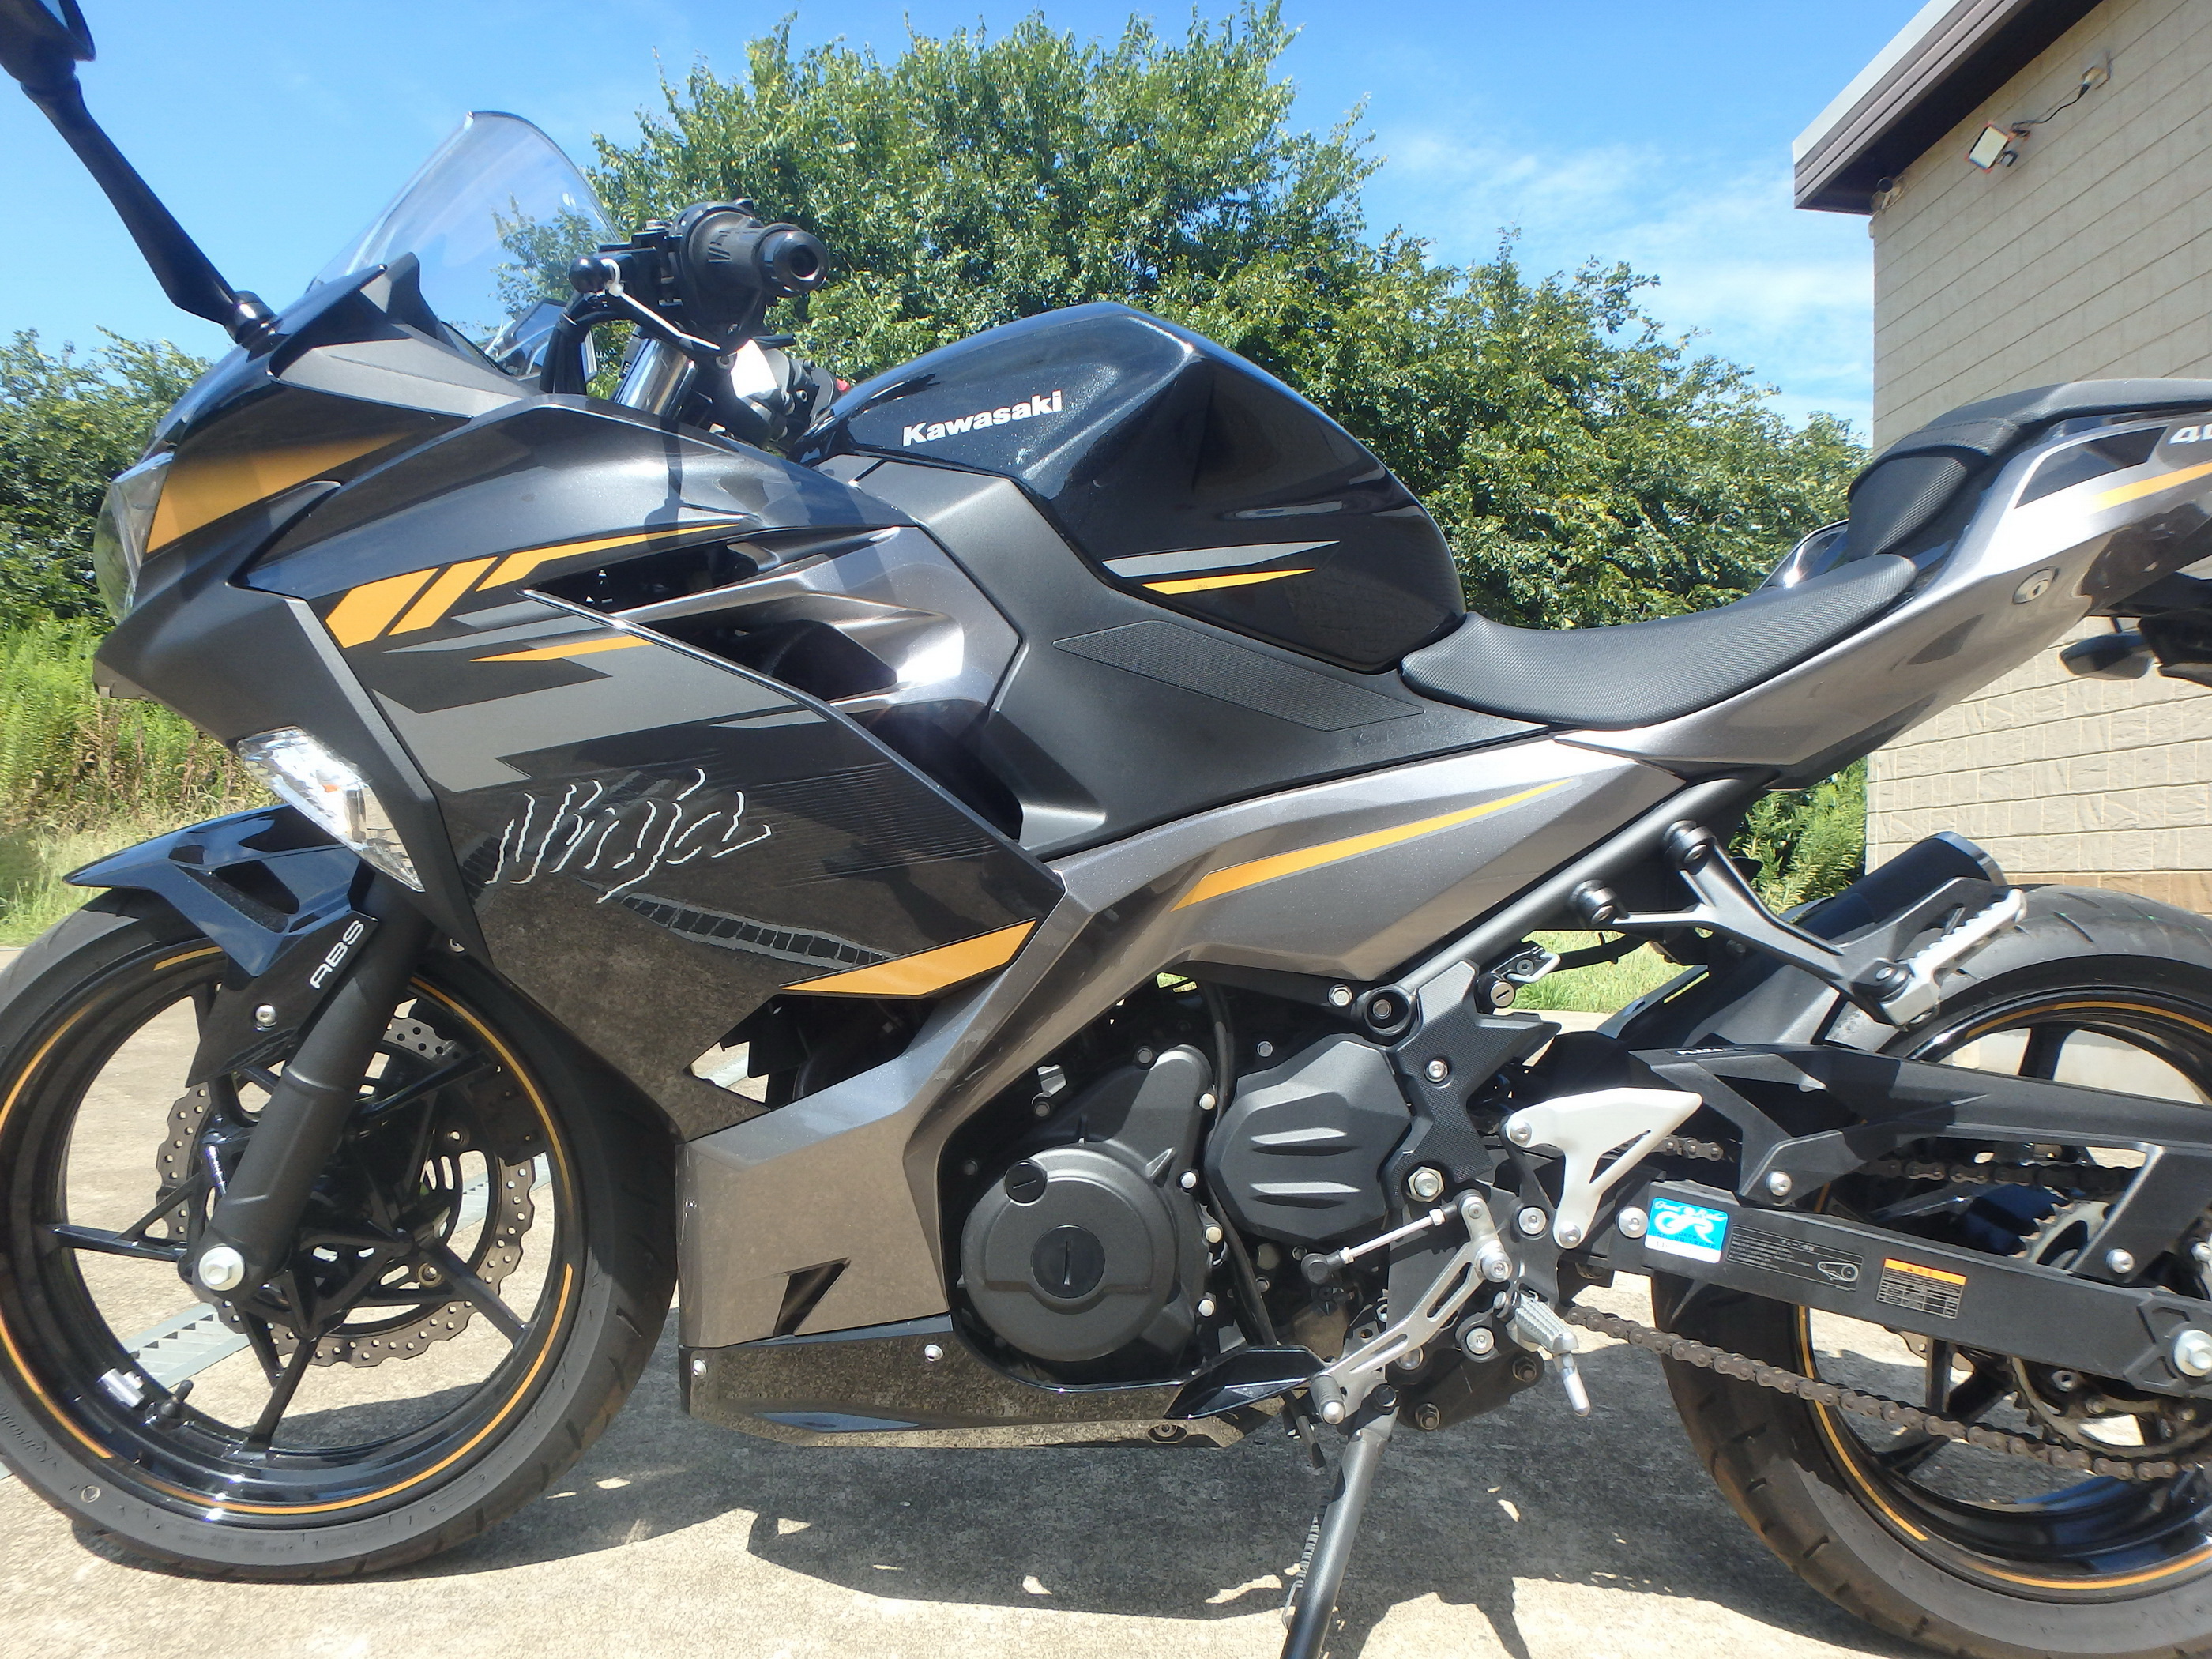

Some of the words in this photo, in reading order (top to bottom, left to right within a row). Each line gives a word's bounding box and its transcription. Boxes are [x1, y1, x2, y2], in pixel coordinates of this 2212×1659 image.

[902, 389, 1063, 447] Kawasaki
[484, 767, 772, 904] Ninja
[310, 920, 364, 989] ABS
